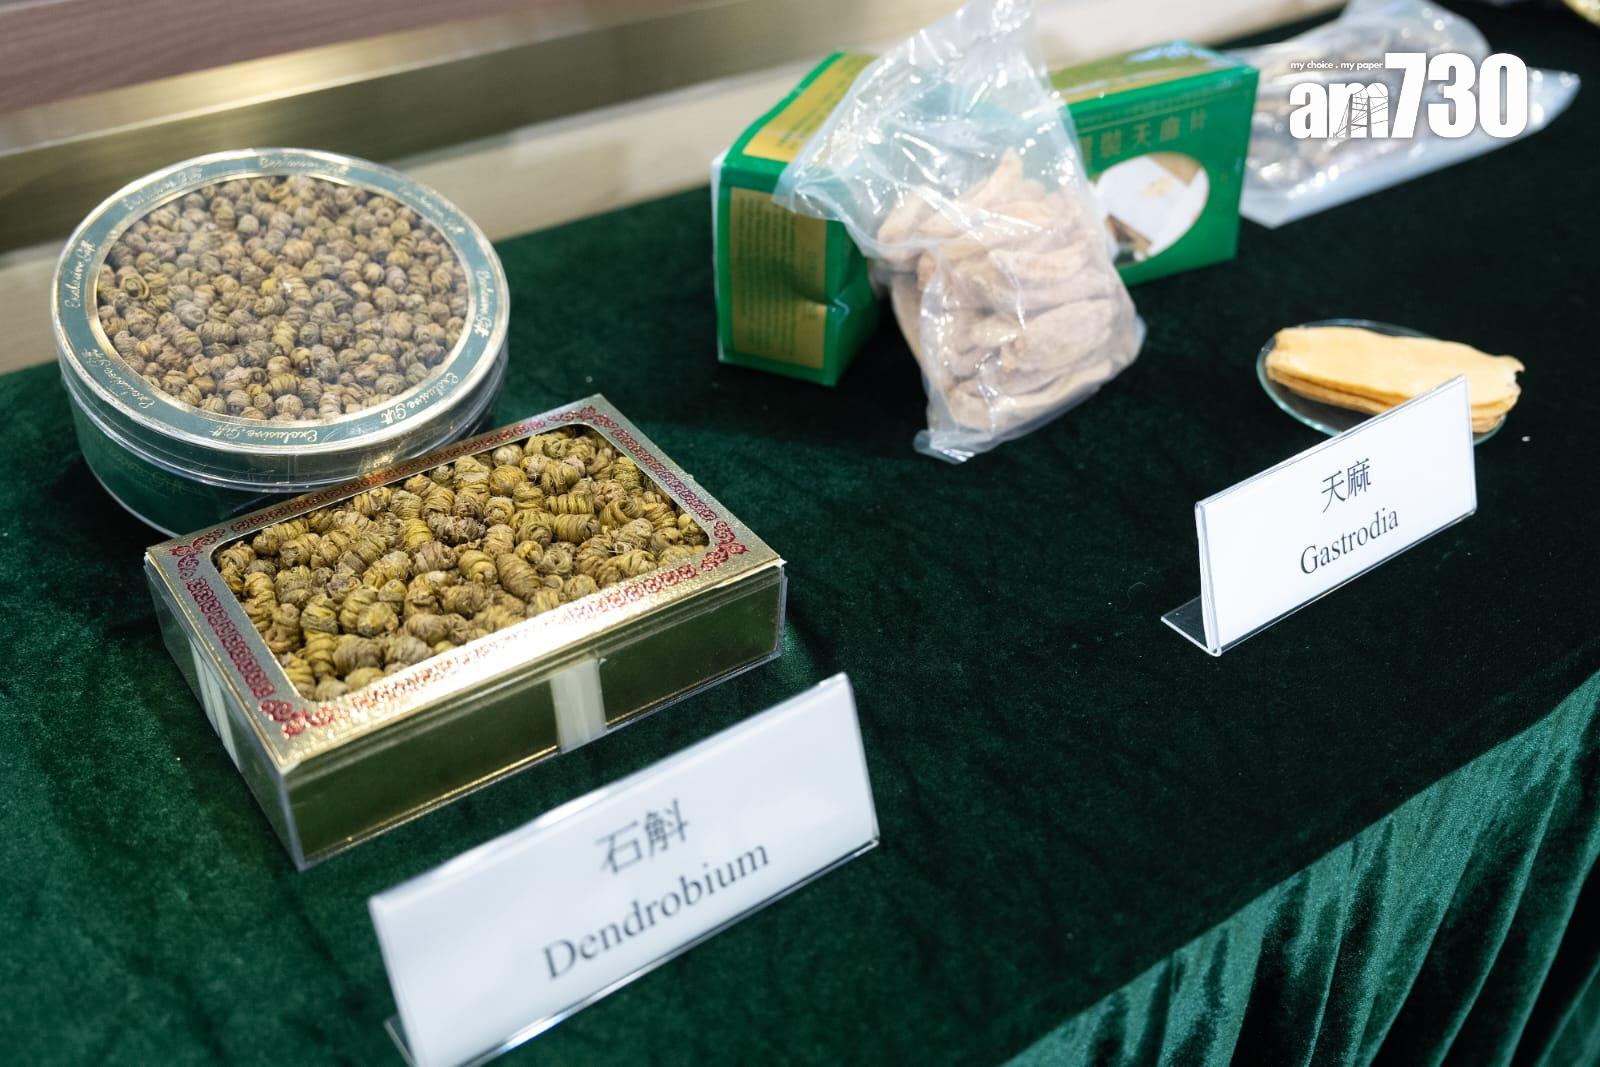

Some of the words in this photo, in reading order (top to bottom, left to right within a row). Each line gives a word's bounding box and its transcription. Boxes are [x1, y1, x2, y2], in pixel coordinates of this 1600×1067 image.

[1321, 458, 1372, 514] 天麻
[1300, 507, 1399, 575] Gastrodia
[596, 799, 688, 874] 石斛
[544, 845, 769, 979] Dendrobium
